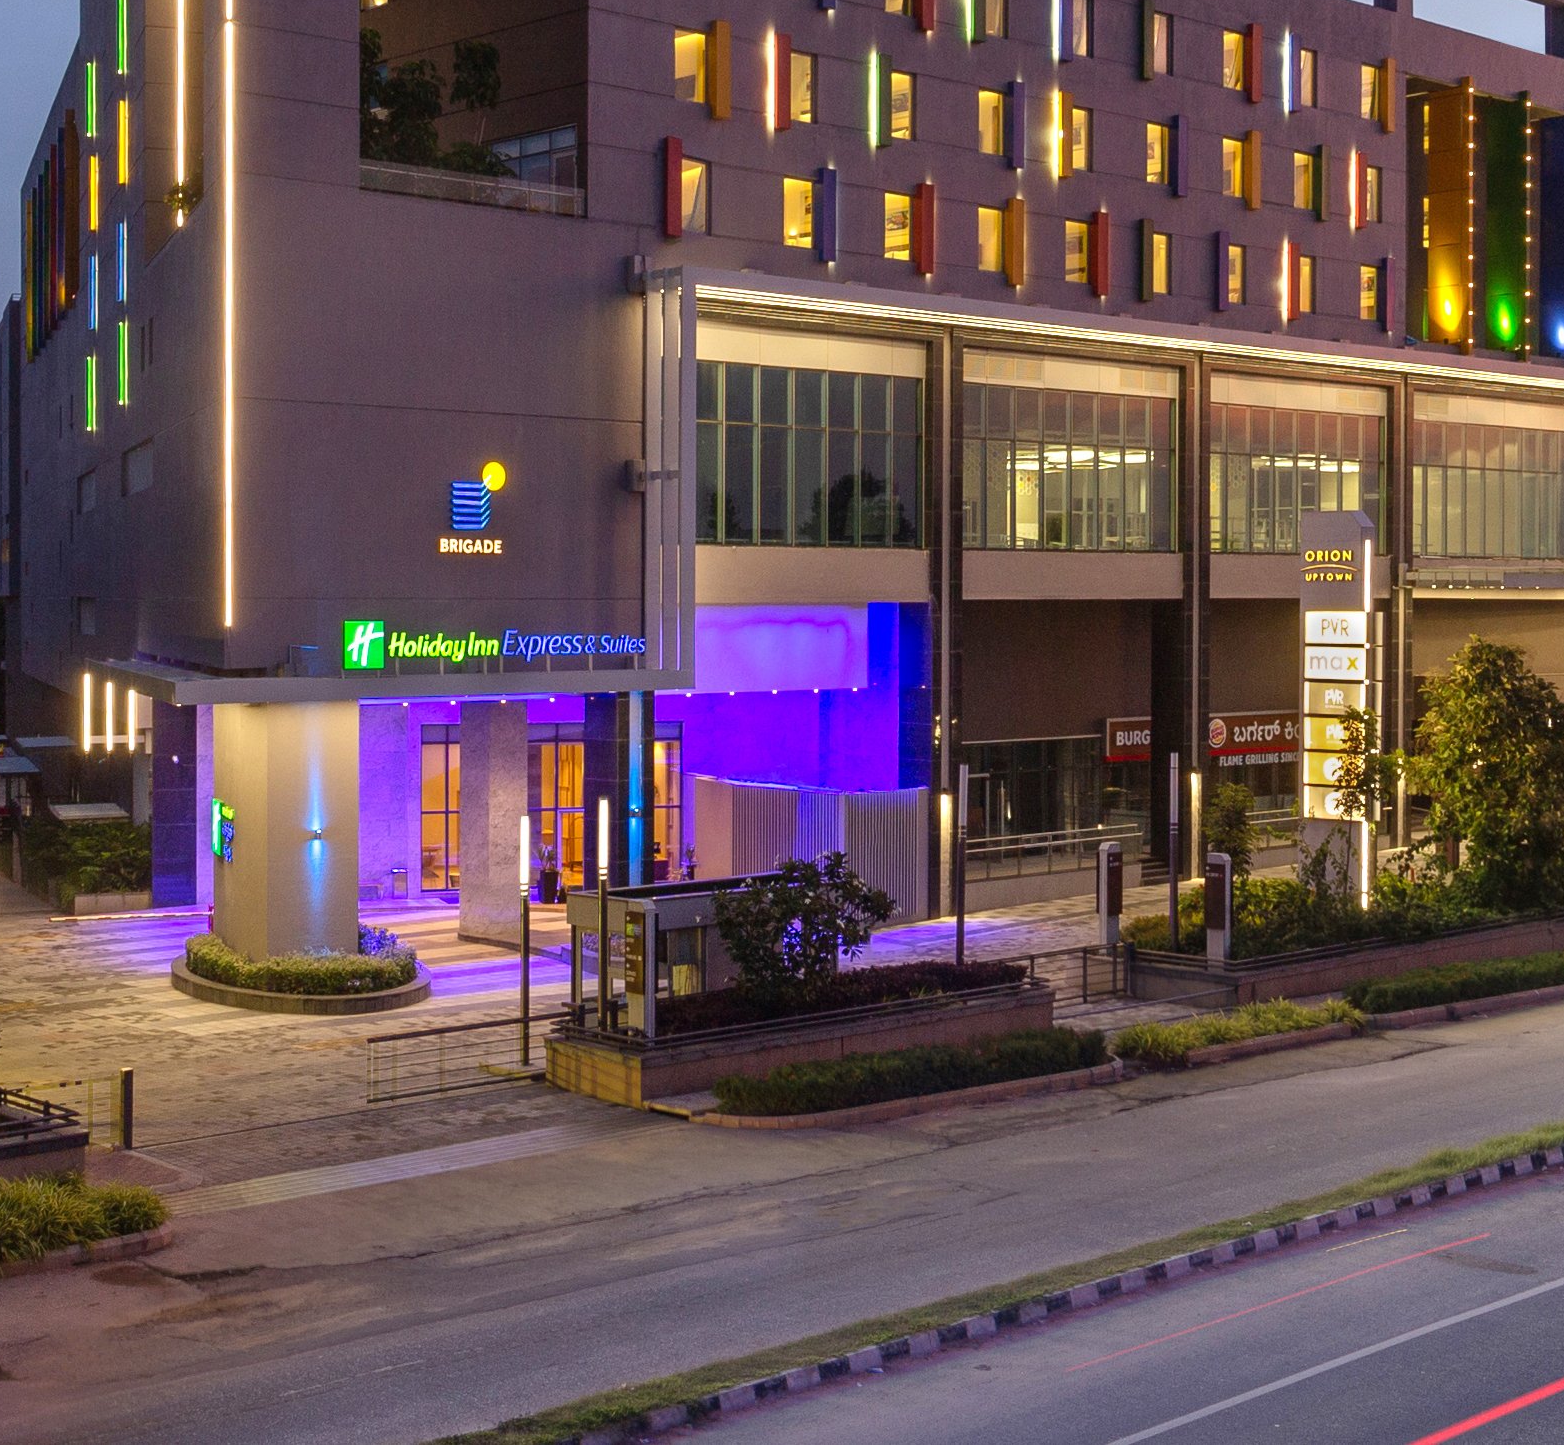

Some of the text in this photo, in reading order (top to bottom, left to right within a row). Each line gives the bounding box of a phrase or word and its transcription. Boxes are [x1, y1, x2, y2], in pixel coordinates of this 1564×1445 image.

[439, 537, 503, 554] BRIGADE
[1304, 549, 1352, 562] ORION
[1305, 572, 1353, 582] UPTOWN
[1321, 618, 1349, 636] PVR
[388, 629, 646, 662] Holiday Inn Express & Suites
[1309, 655, 1359, 671] max
[1324, 688, 1344, 705] PVR
[1219, 754, 1243, 767] FLAME
[1245, 752, 1279, 765] GRILLING
